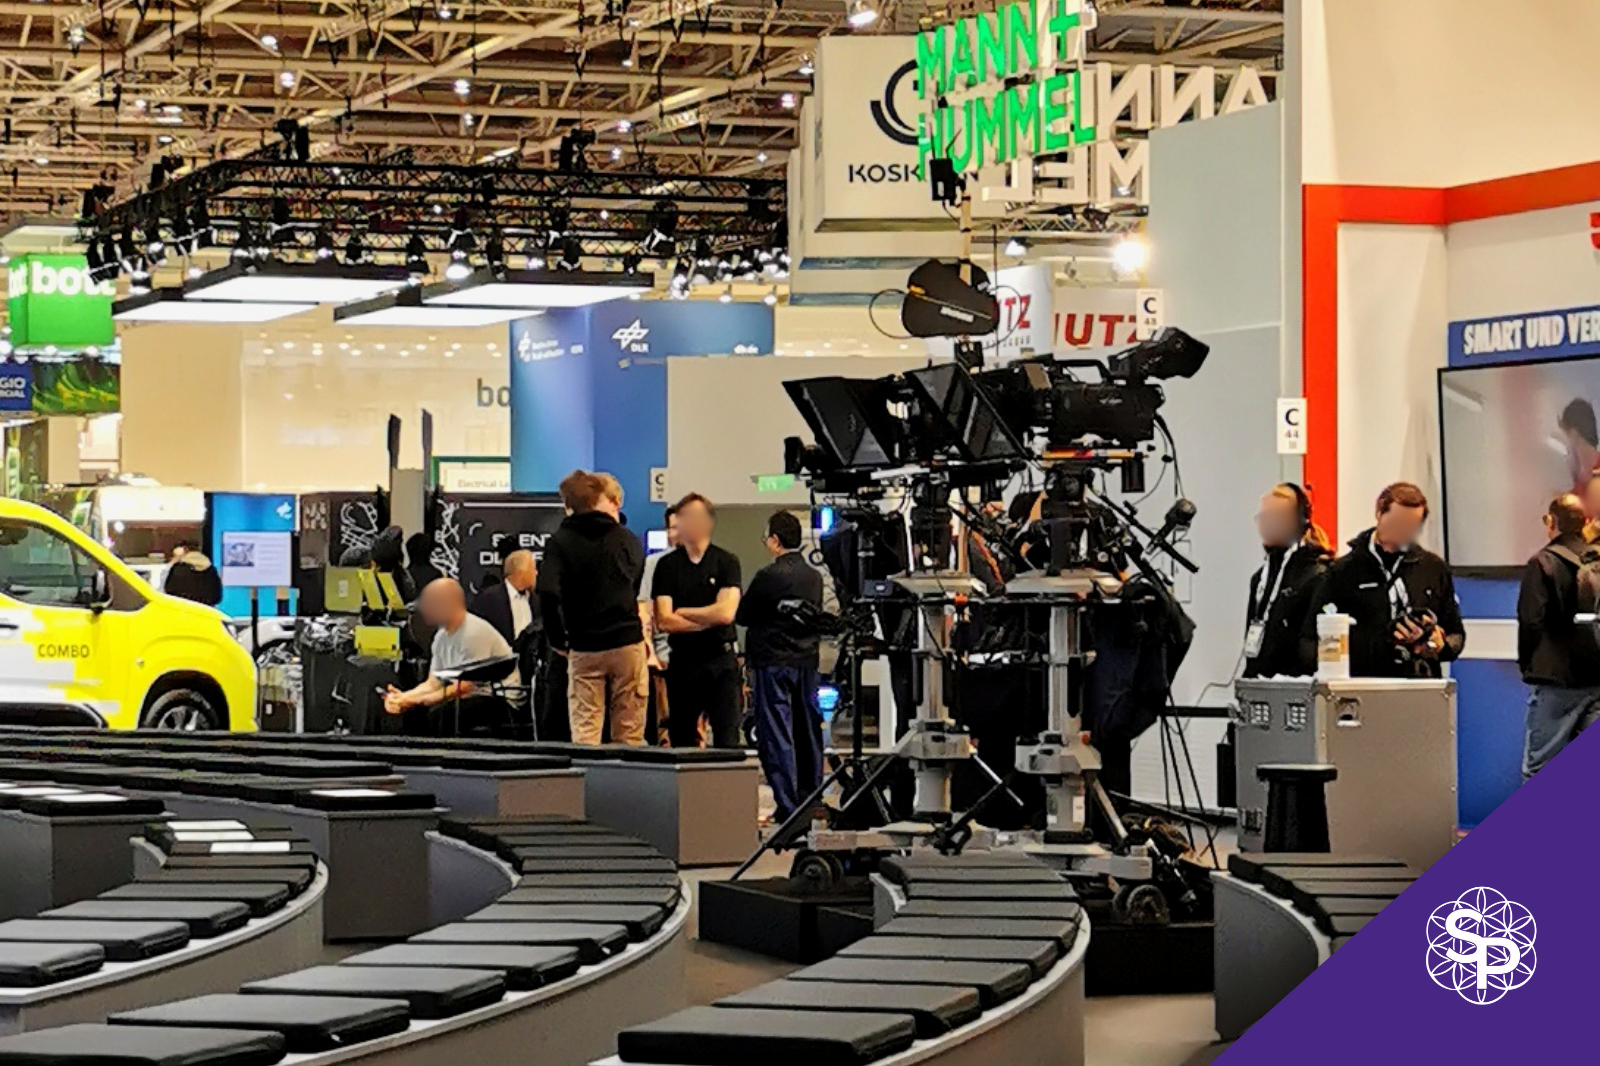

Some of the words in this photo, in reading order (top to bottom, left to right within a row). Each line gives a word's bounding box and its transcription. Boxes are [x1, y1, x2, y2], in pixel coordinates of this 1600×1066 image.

[918, 71, 1097, 181] HUMMEL
[1005, 294, 1031, 332] TZ
[1143, 297, 1157, 314] C
[1464, 319, 1523, 355] SMART
[1526, 315, 1565, 348] UND
[1285, 408, 1299, 426] C
[38, 644, 90, 658] COMBO
